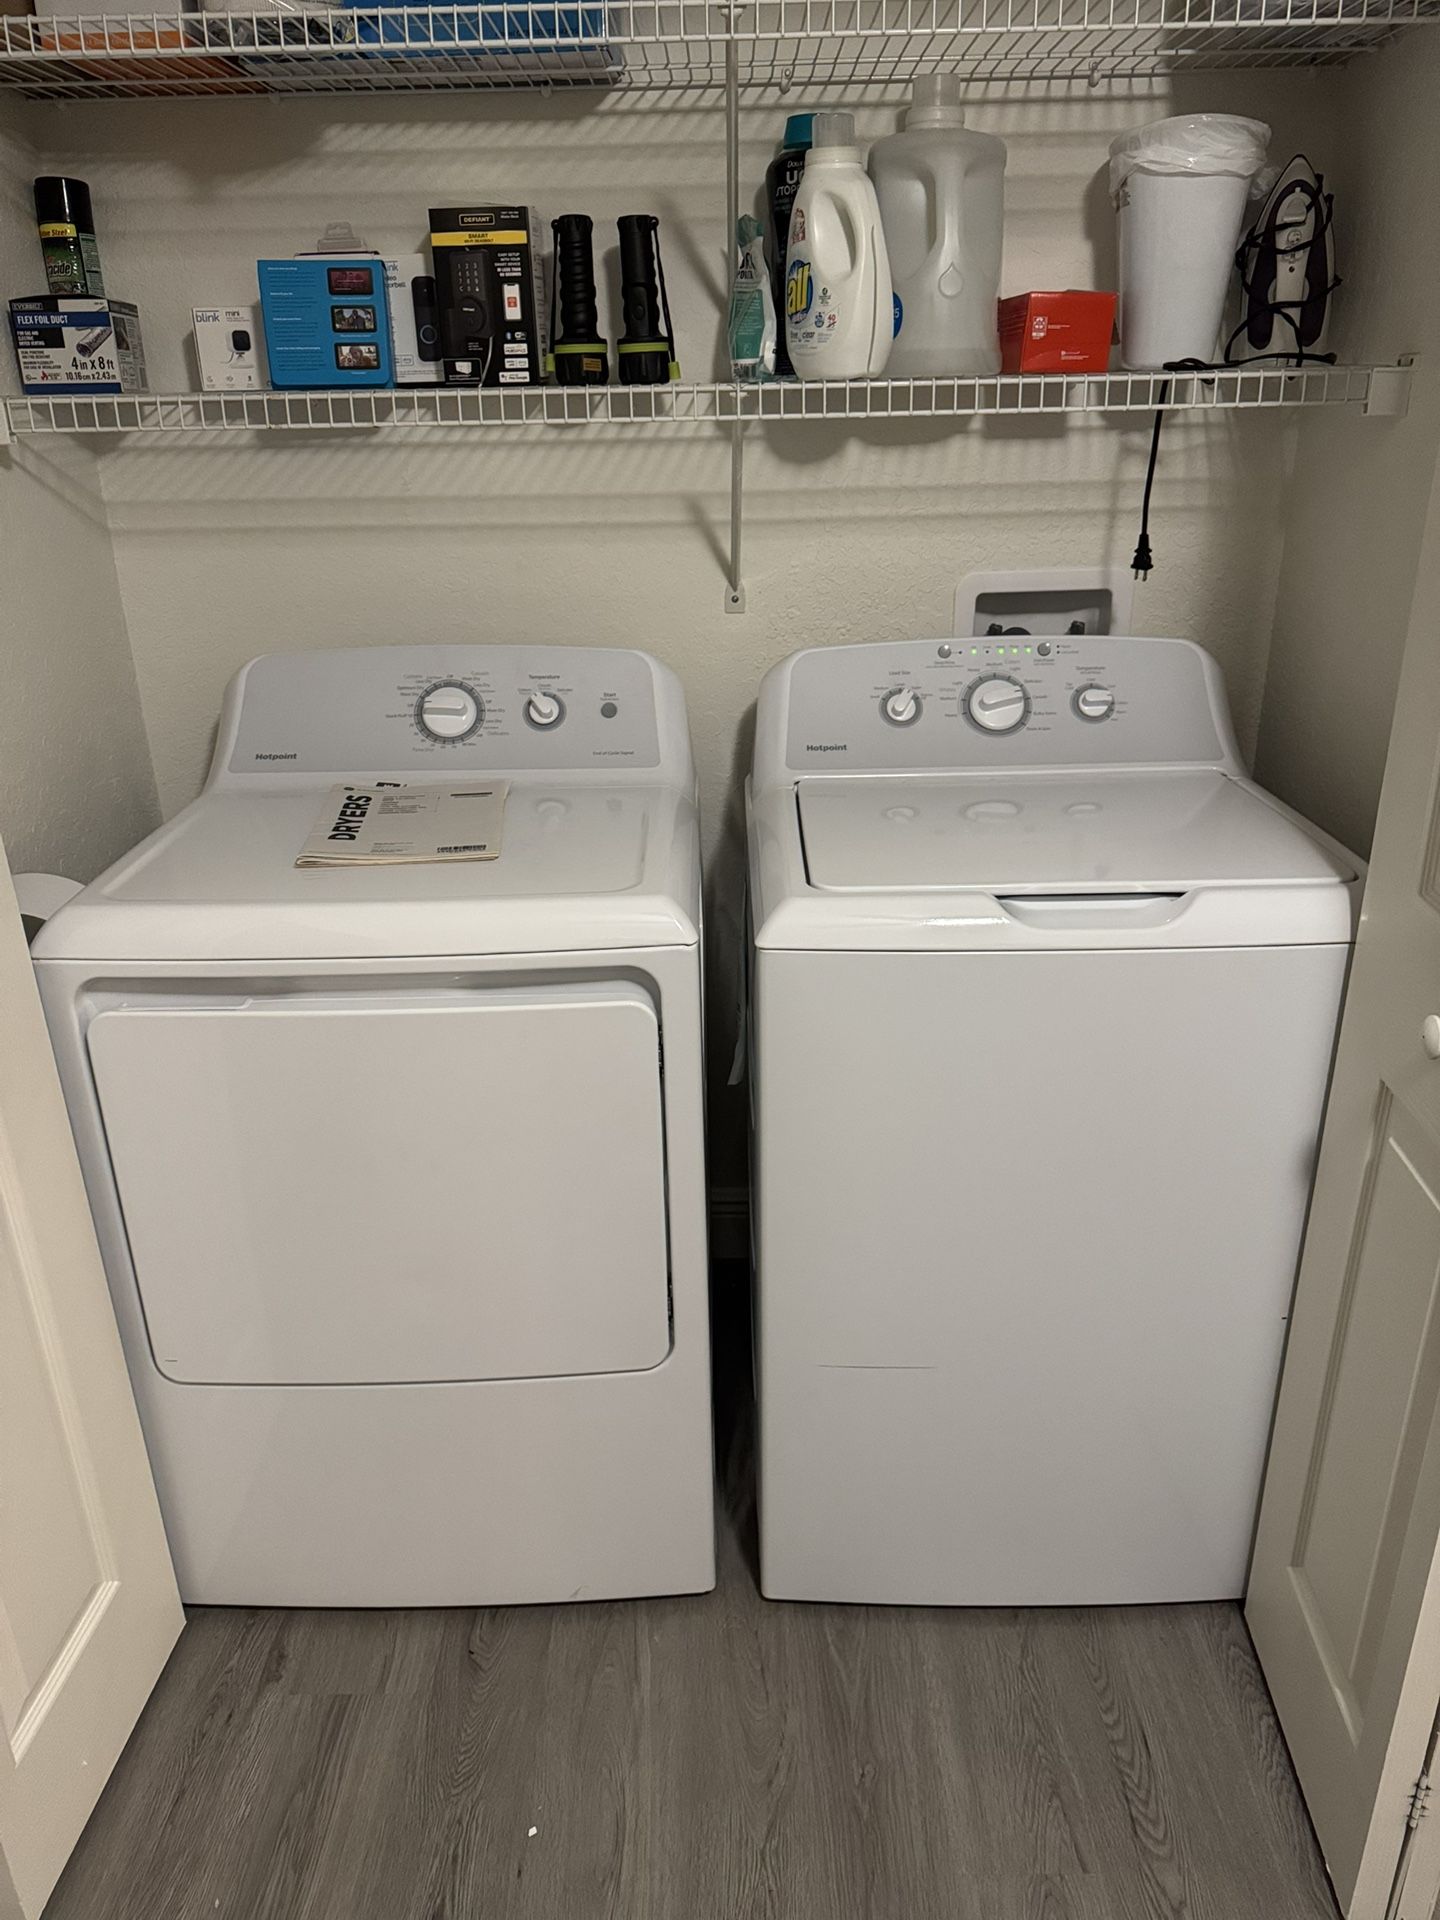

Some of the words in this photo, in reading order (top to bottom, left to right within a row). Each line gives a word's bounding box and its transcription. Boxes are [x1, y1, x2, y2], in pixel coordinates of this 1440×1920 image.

[786, 169, 804, 185] U
[787, 262, 811, 316] all
[17, 315, 34, 325] FLEX
[34, 315, 50, 325] FOIL
[50, 315, 68, 324] DUCT
[195, 312, 220, 323] blink
[71, 357, 78, 370] 4
[79, 360, 88, 370] in
[98, 356, 106, 370] 8
[106, 359, 115, 370] ft
[65, 371, 82, 380] 10.16
[96, 371, 110, 380] 2.43
[806, 744, 847, 752] Hotpoint
[255, 753, 297, 761] Hotpoint
[327, 795, 373, 841] DRYERS
